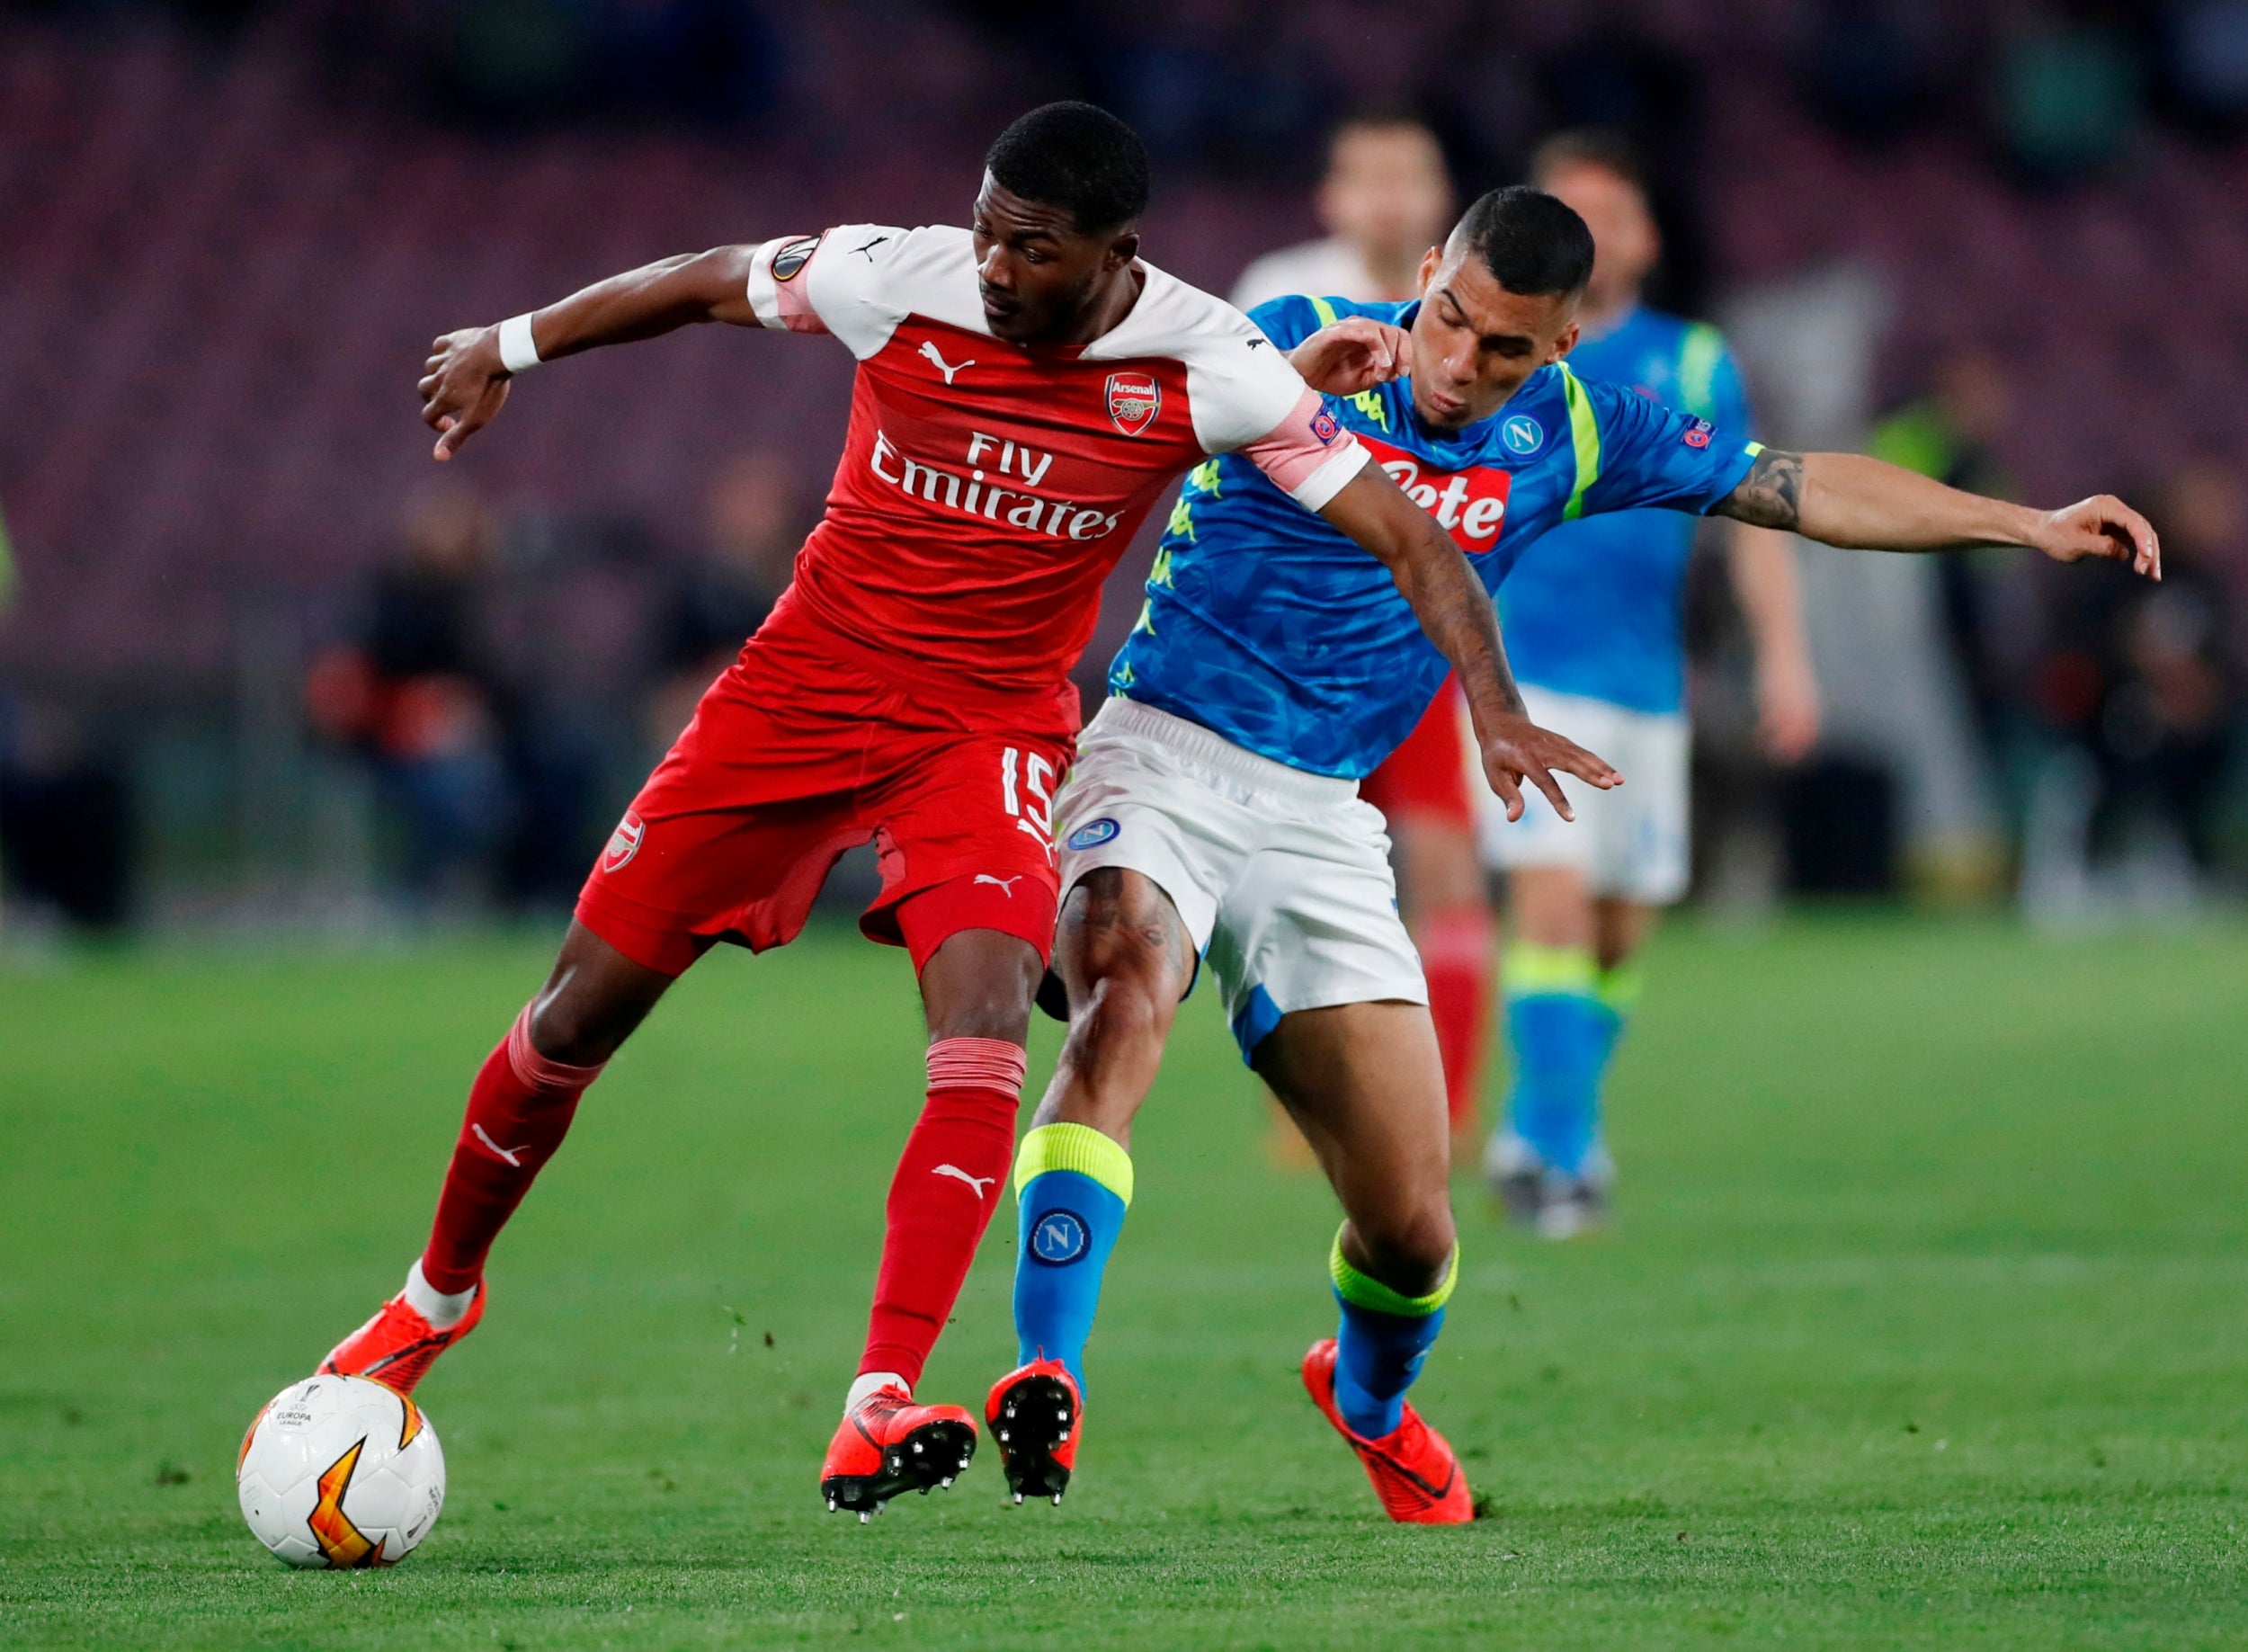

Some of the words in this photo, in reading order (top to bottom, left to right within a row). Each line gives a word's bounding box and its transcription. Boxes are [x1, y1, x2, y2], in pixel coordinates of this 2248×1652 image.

[1112, 381, 1154, 395] Arsenal
[1510, 423, 1534, 448] N
[966, 431, 1054, 487] Fly
[870, 428, 1126, 540] Emirates
[1002, 746, 1054, 837] 15
[1044, 1223, 1070, 1252] N
[276, 1411, 312, 1422] EUROPA
